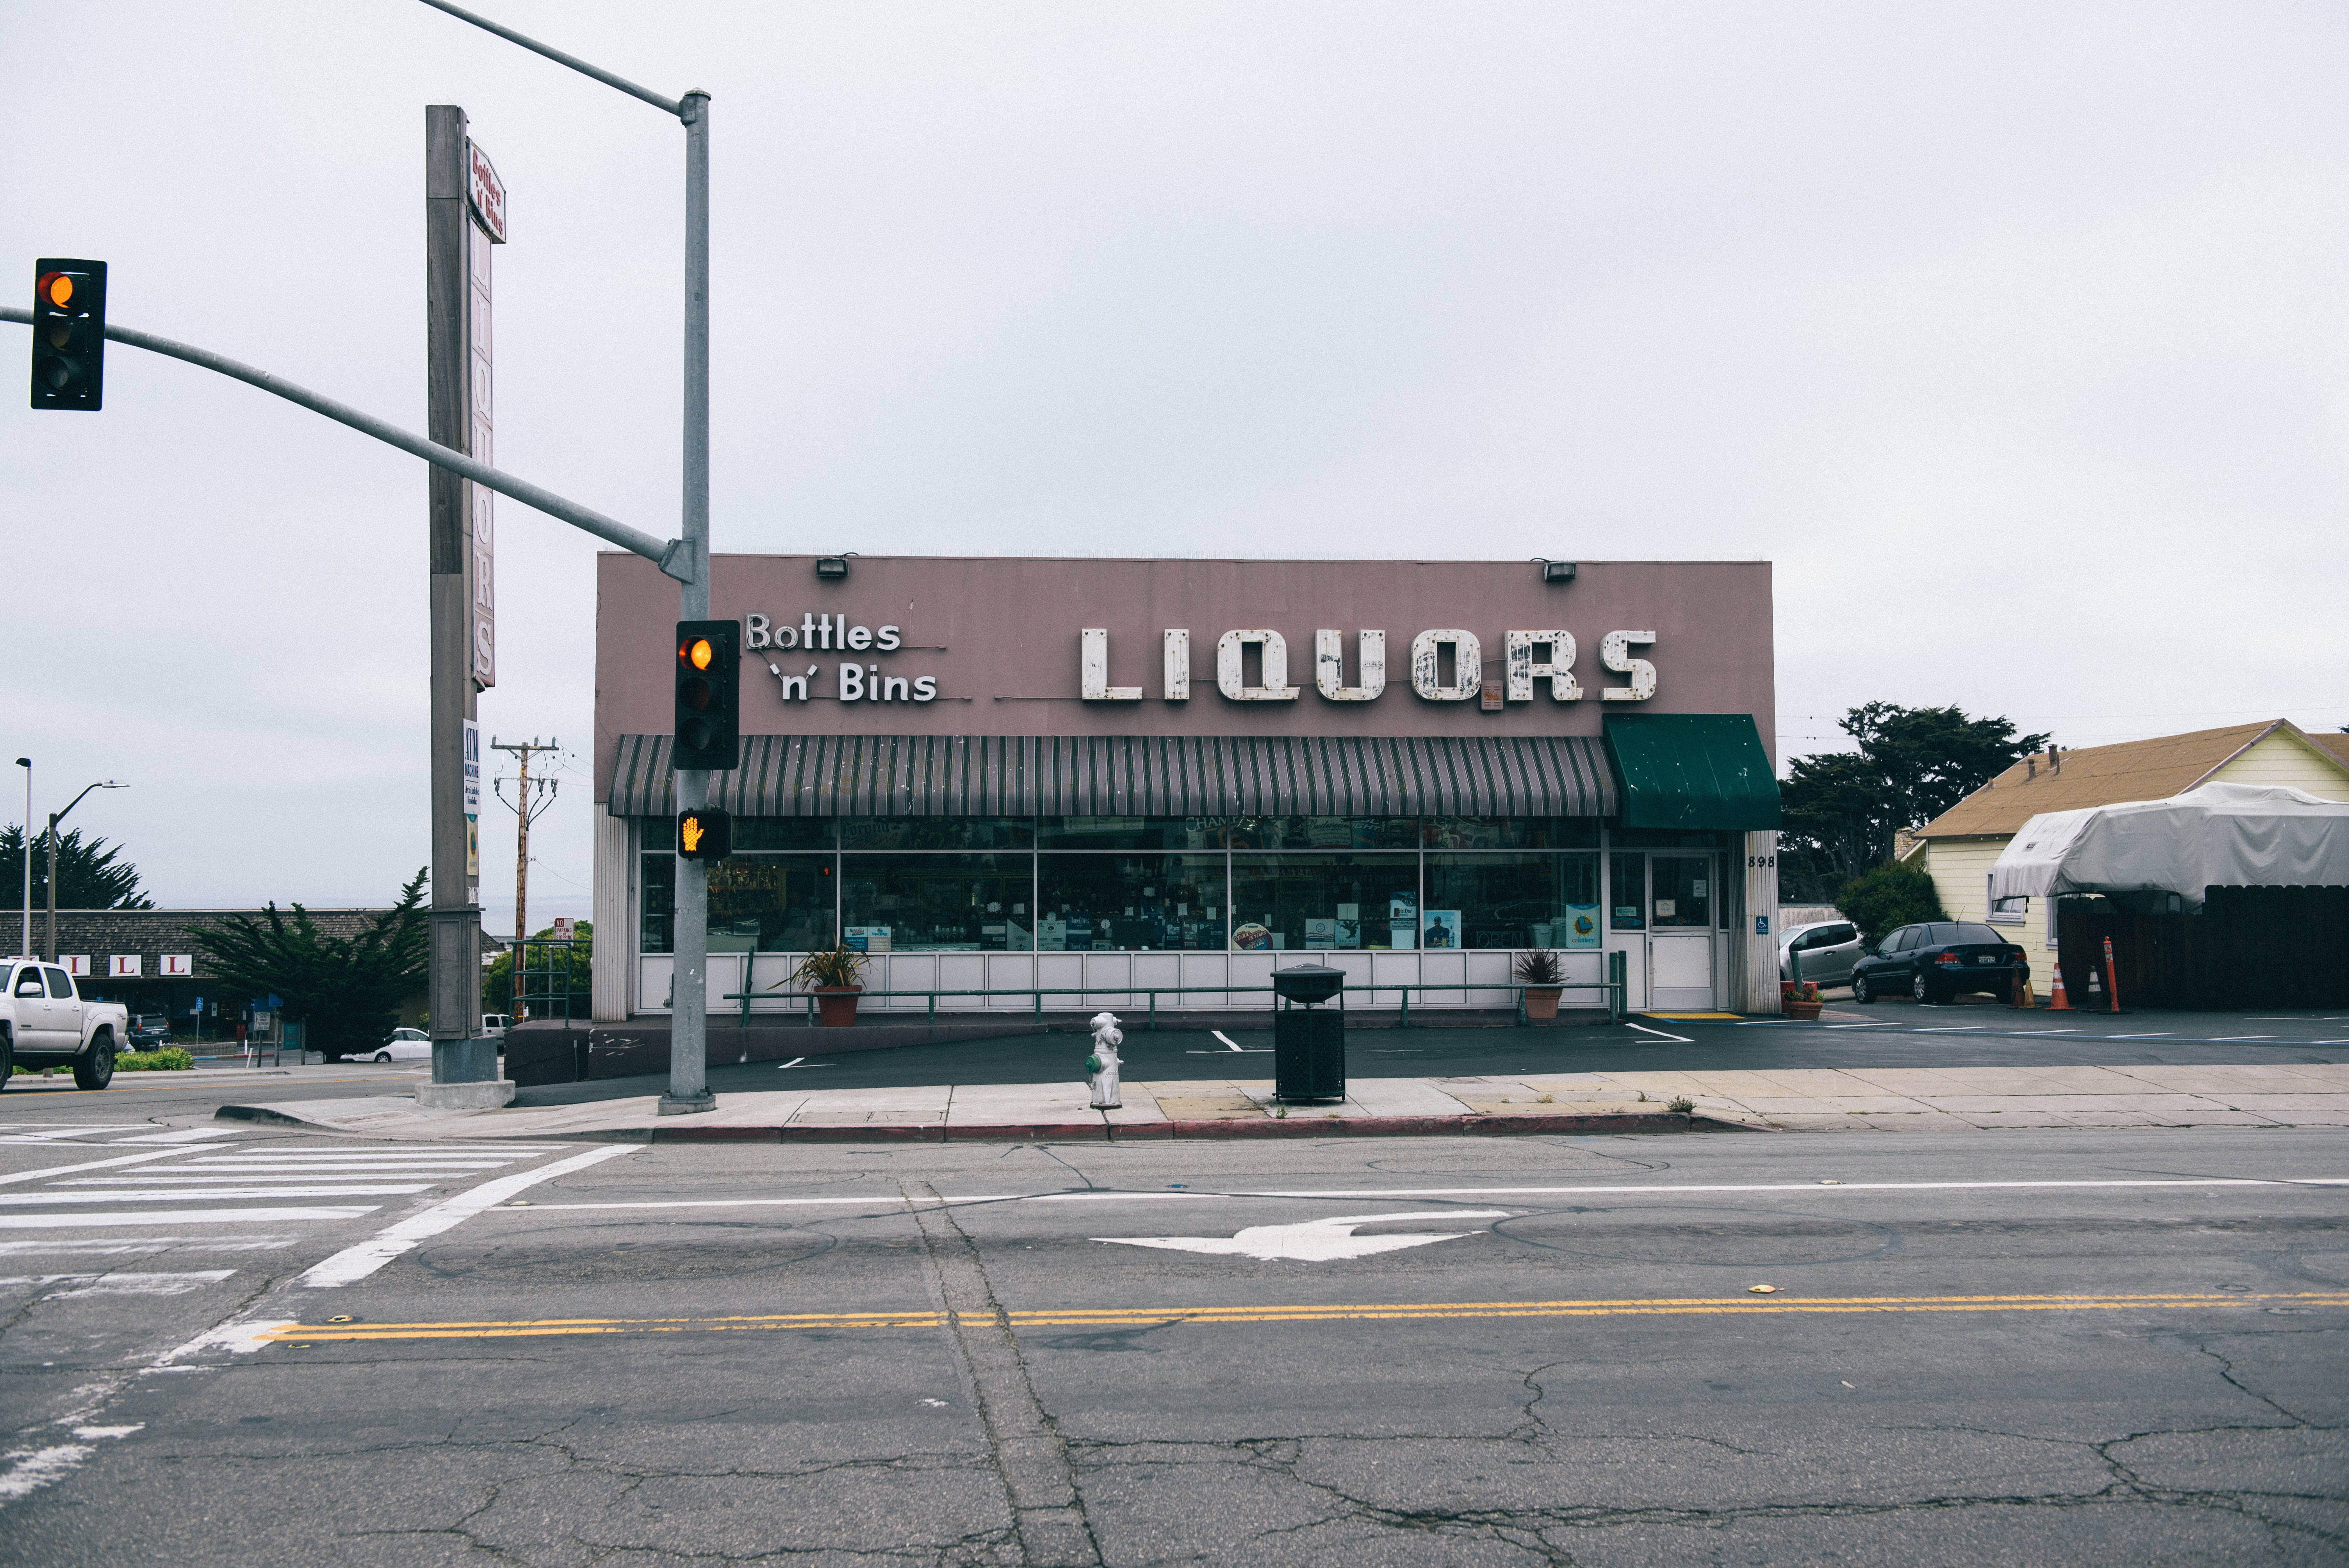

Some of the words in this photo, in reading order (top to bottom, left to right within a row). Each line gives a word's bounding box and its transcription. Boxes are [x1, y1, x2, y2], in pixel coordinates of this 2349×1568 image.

[473, 149, 501, 207] Bottles
[485, 194, 503, 235] Bins
[746, 612, 900, 650] Bottles
[1082, 628, 1657, 702] LIQUORS
[840, 663, 936, 700] Bins
[465, 728, 478, 762] ATM
[465, 764, 479, 778] MACHINE
[465, 786, 479, 795] Available
[467, 796, 477, 805] Inside
[841, 822, 889, 835] Corona
[1308, 819, 1350, 830] Budweiser
[1748, 857, 1775, 867] 898
[1234, 932, 1249, 941] $20,000
[1254, 930, 1267, 939] YEARS
[1479, 933, 1521, 947] OPEN
